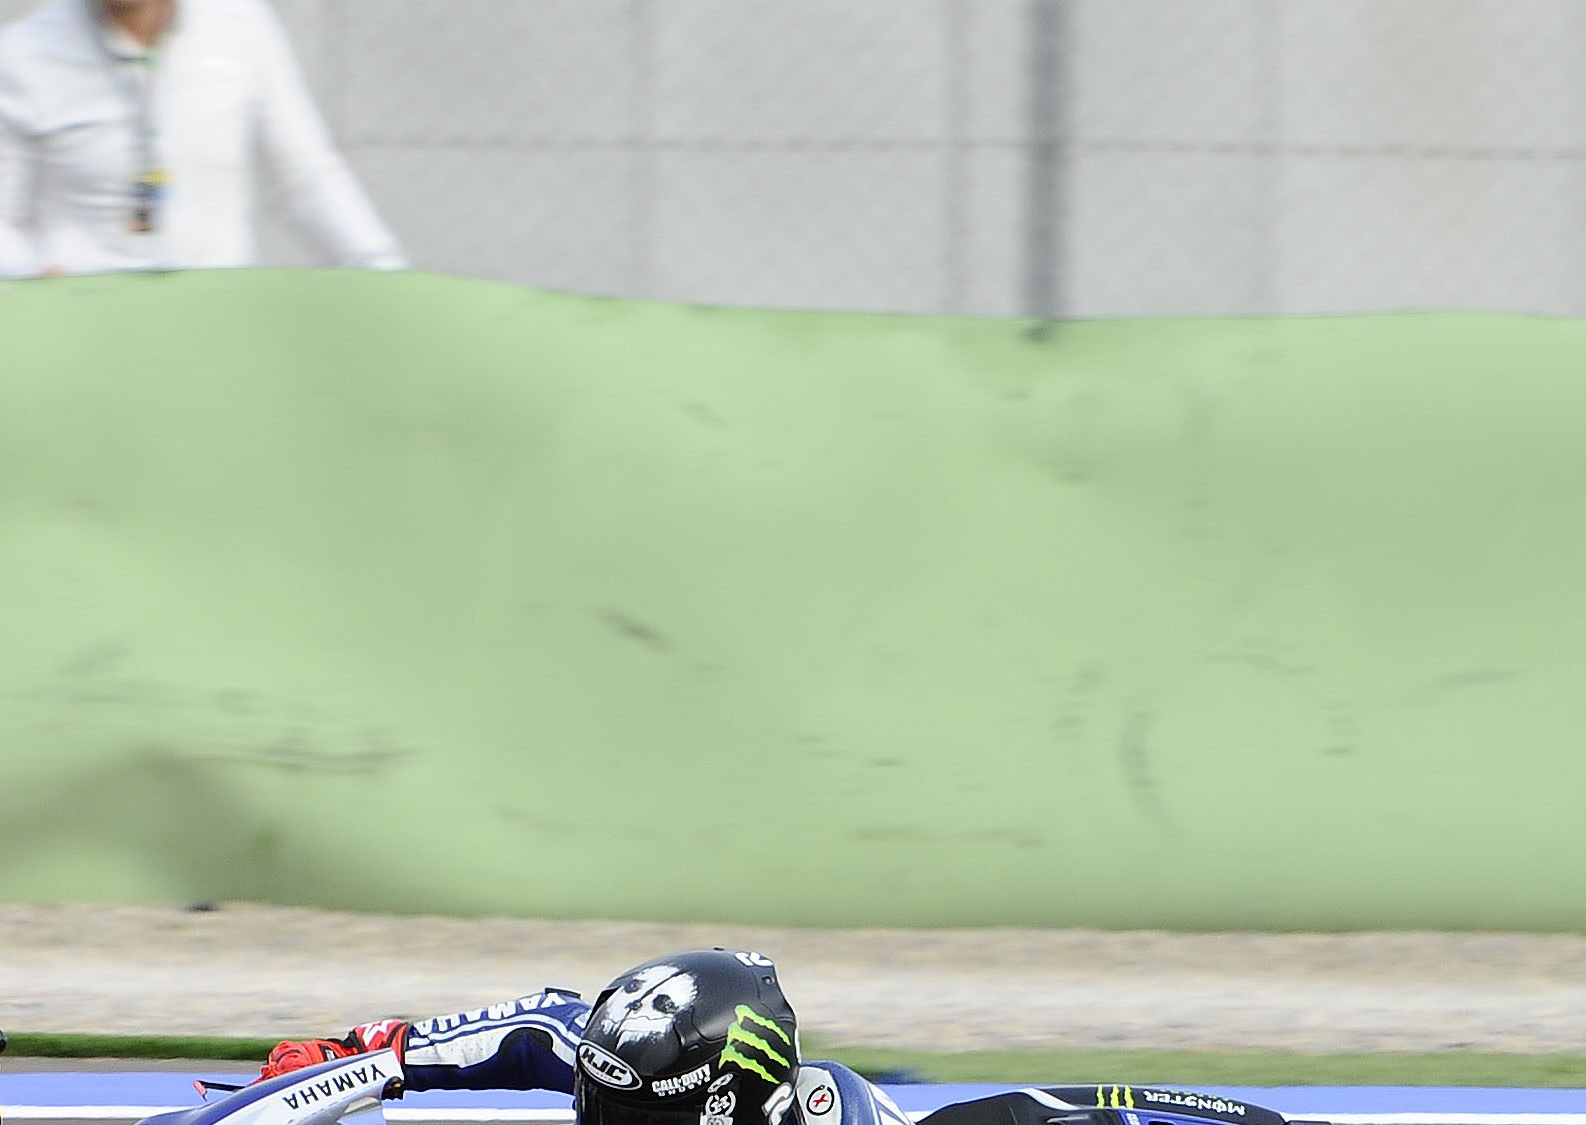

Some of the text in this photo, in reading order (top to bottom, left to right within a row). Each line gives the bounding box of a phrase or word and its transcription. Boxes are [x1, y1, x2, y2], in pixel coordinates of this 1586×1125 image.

[414, 992, 566, 1036] YAMAHA
[582, 1047, 628, 1082] HJC
[282, 1063, 386, 1110] YAMAHA
[1143, 1090, 1246, 1116] MONSTER
